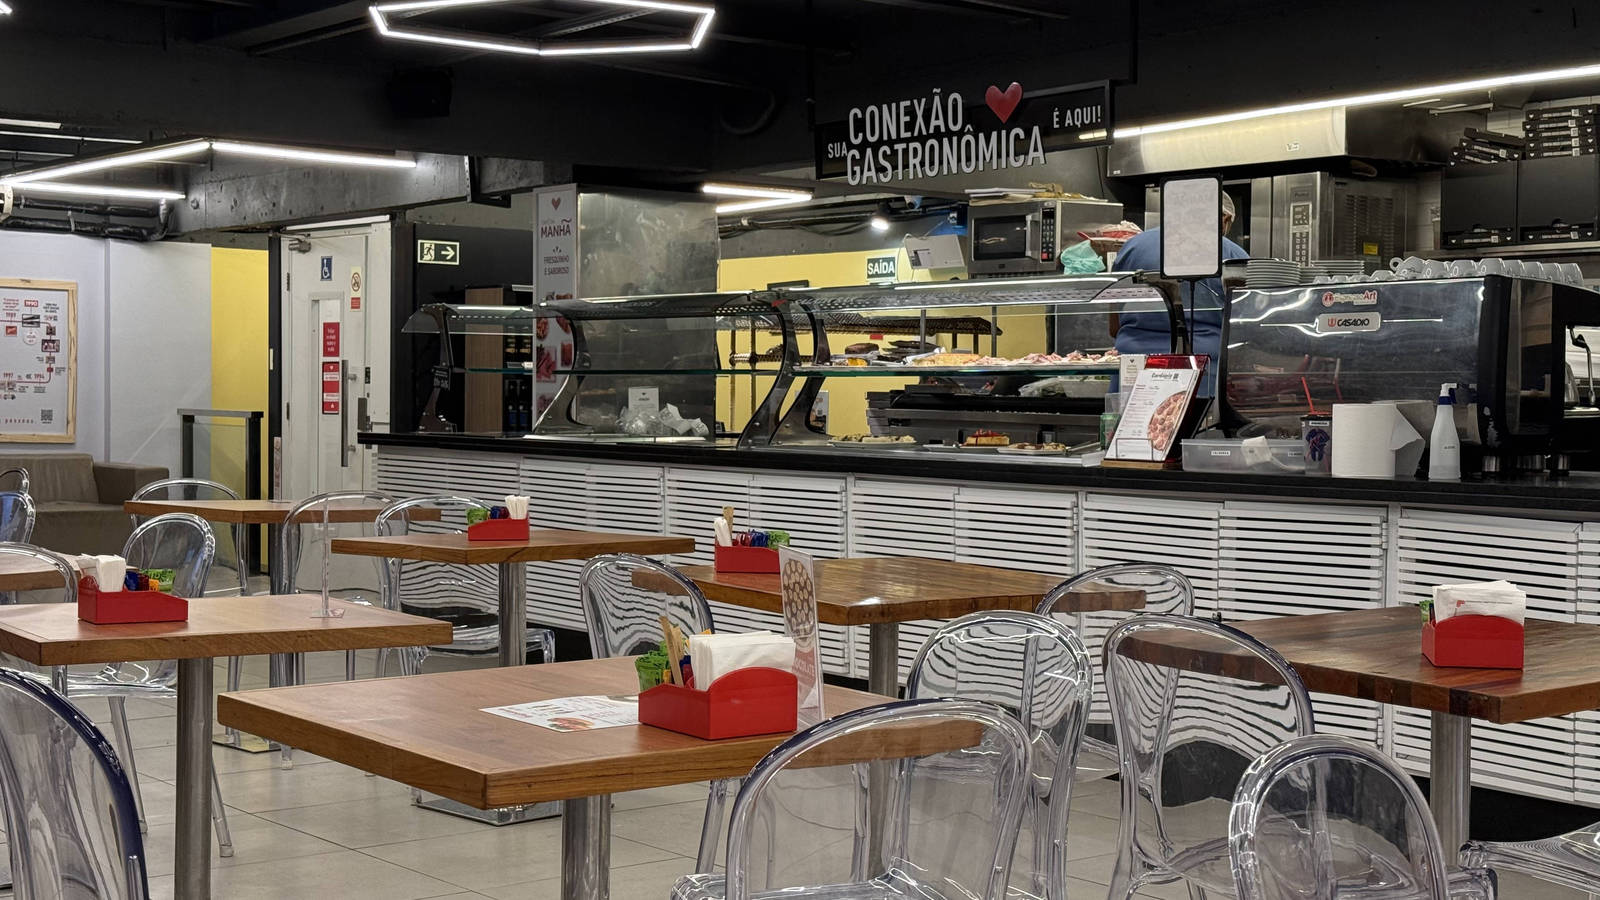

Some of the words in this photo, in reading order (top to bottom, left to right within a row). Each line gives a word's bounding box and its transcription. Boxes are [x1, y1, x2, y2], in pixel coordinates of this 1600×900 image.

[848, 87, 964, 145] CONEXÃO
[1053, 108, 1060, 129] É
[1065, 105, 1102, 128] AQUI!
[828, 143, 848, 159] SUA
[846, 125, 1046, 187] GASTRONÔMICA
[540, 218, 572, 238] MANHÃ
[868, 260, 895, 274] SAÍDA
[1337, 318, 1370, 327] CASADIO
